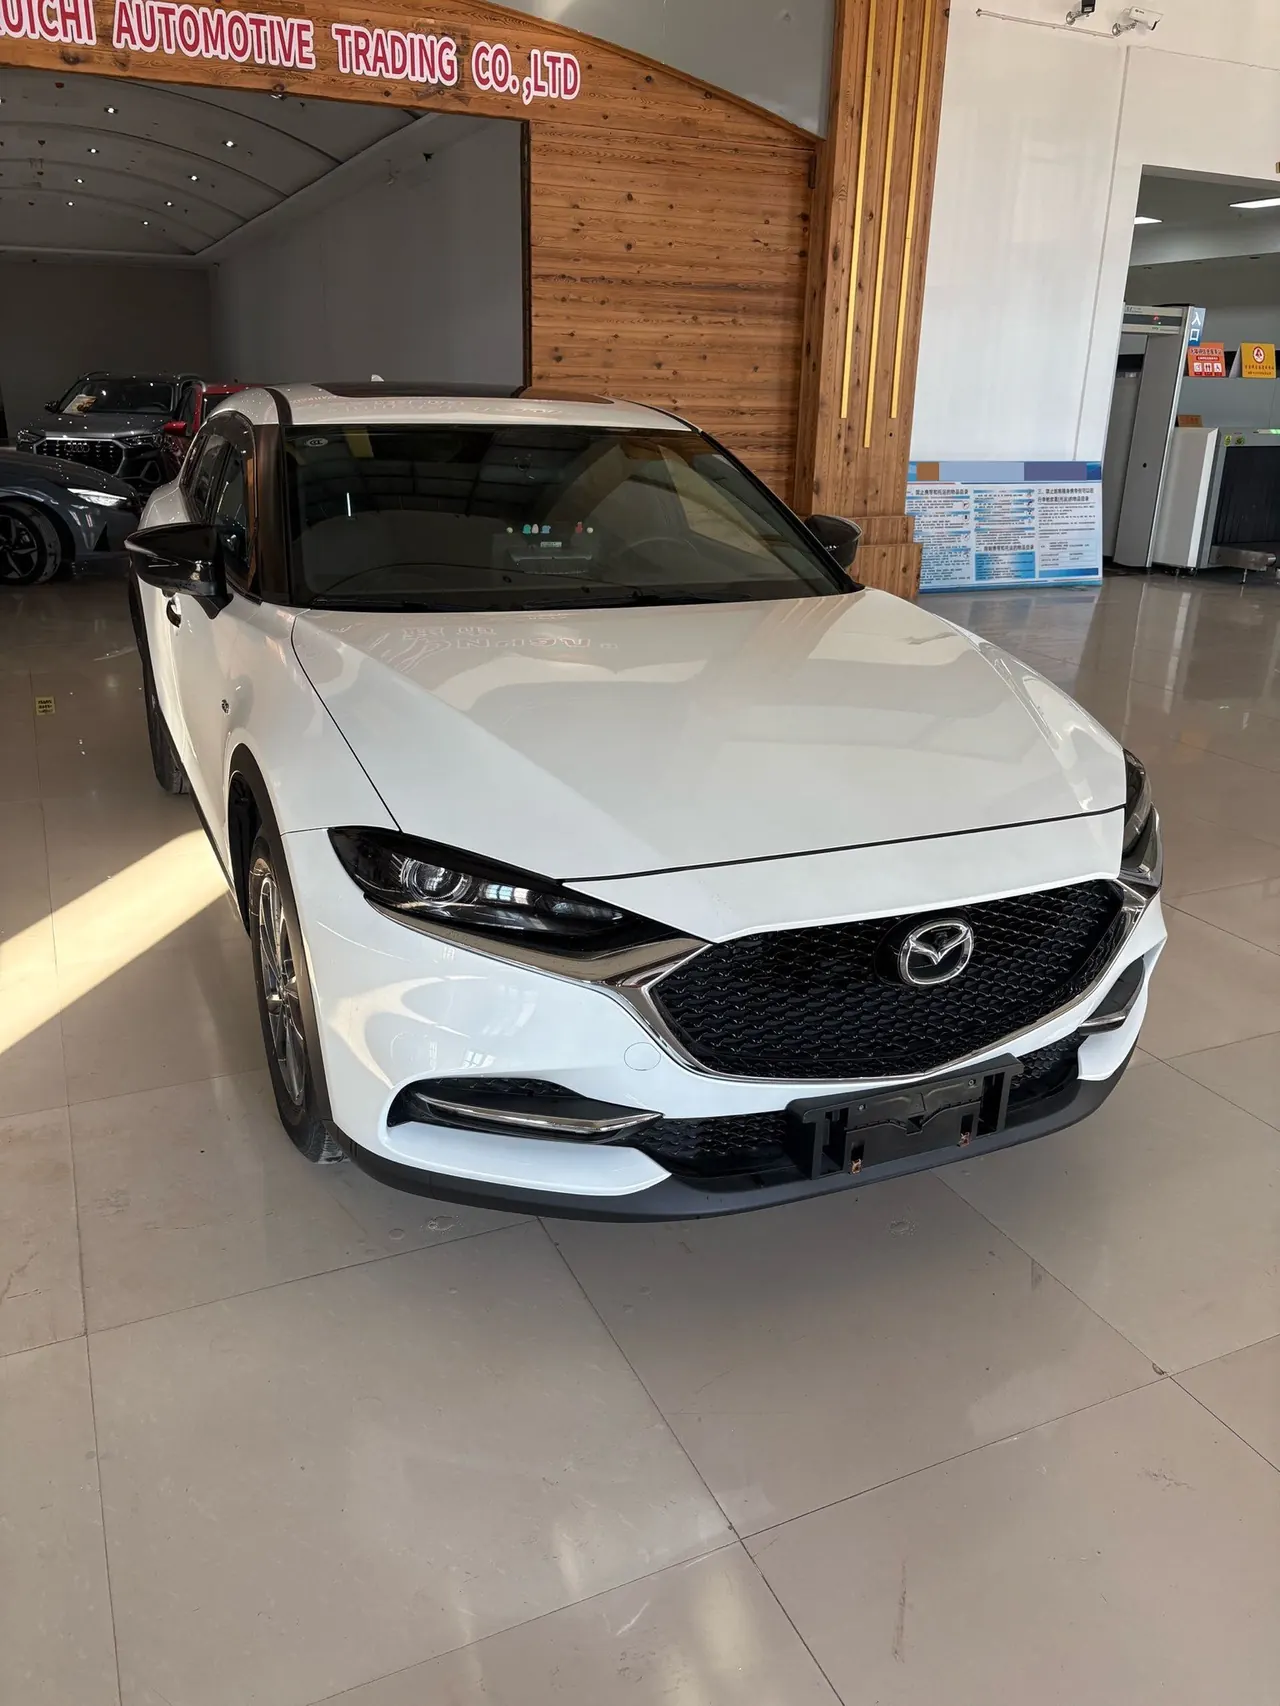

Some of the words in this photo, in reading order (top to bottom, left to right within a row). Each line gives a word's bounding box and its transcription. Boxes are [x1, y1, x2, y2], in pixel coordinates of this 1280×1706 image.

[0, 0, 96, 45] UICHI
[113, 0, 316, 69] AUTOMOTIVE
[332, 23, 457, 86] TRADING
[1189, 311, 1202, 342] 入口
